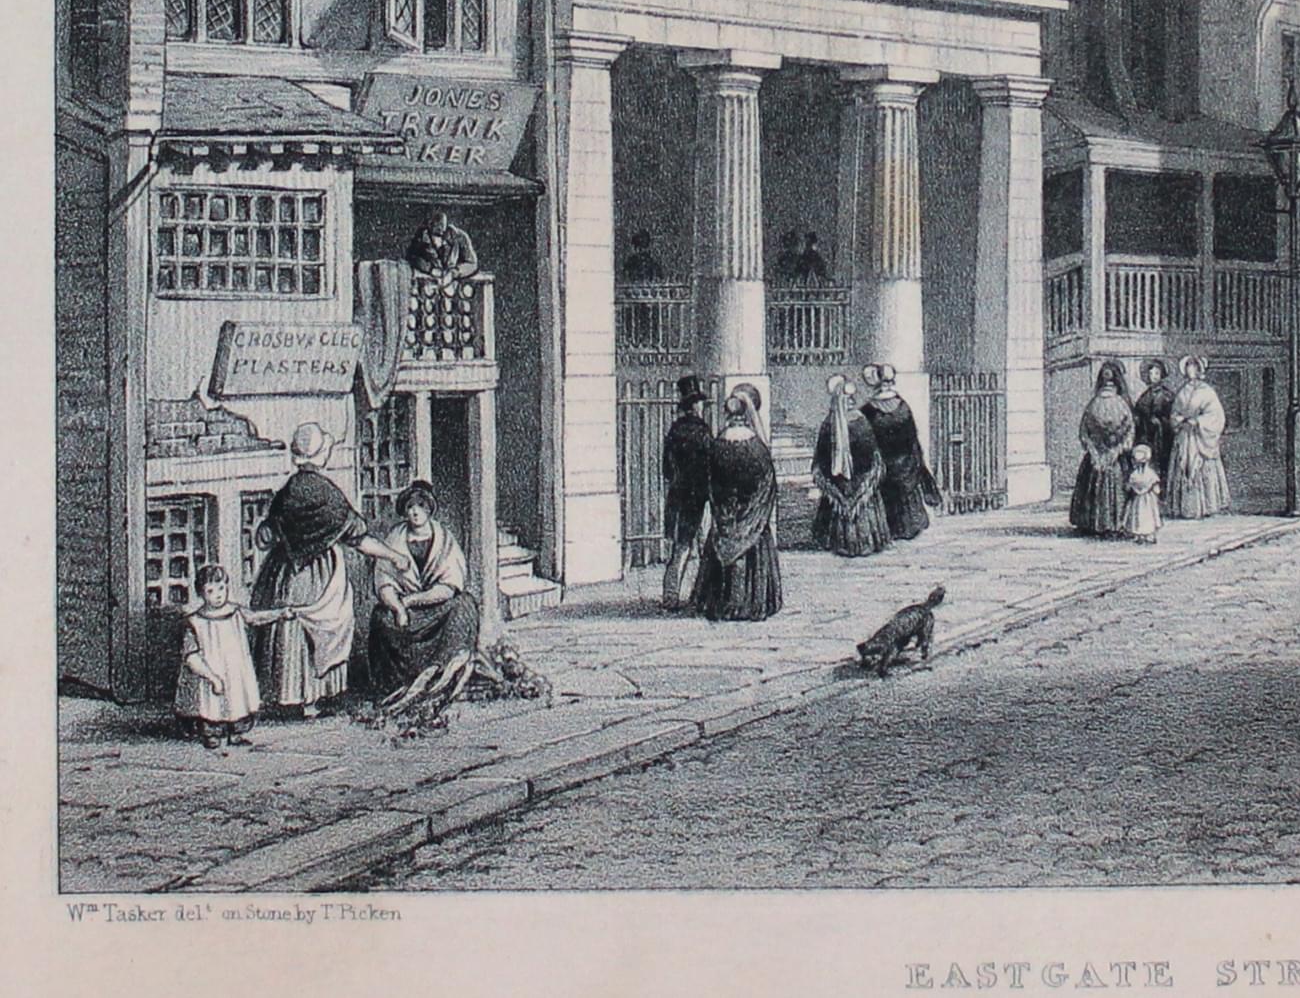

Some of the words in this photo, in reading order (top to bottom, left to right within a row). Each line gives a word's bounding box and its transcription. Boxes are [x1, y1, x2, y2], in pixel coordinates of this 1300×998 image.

[405, 84, 501, 111] JONES
[379, 111, 507, 142] TRUNK
[234, 331, 306, 348] CROSBY
[232, 358, 350, 375] PLASTERS
[103, 903, 166, 922] Tasker
[245, 904, 292, 920] Stone
[294, 904, 317, 924] by
[338, 903, 402, 920] Picken
[904, 961, 1174, 989] EASTGATE
